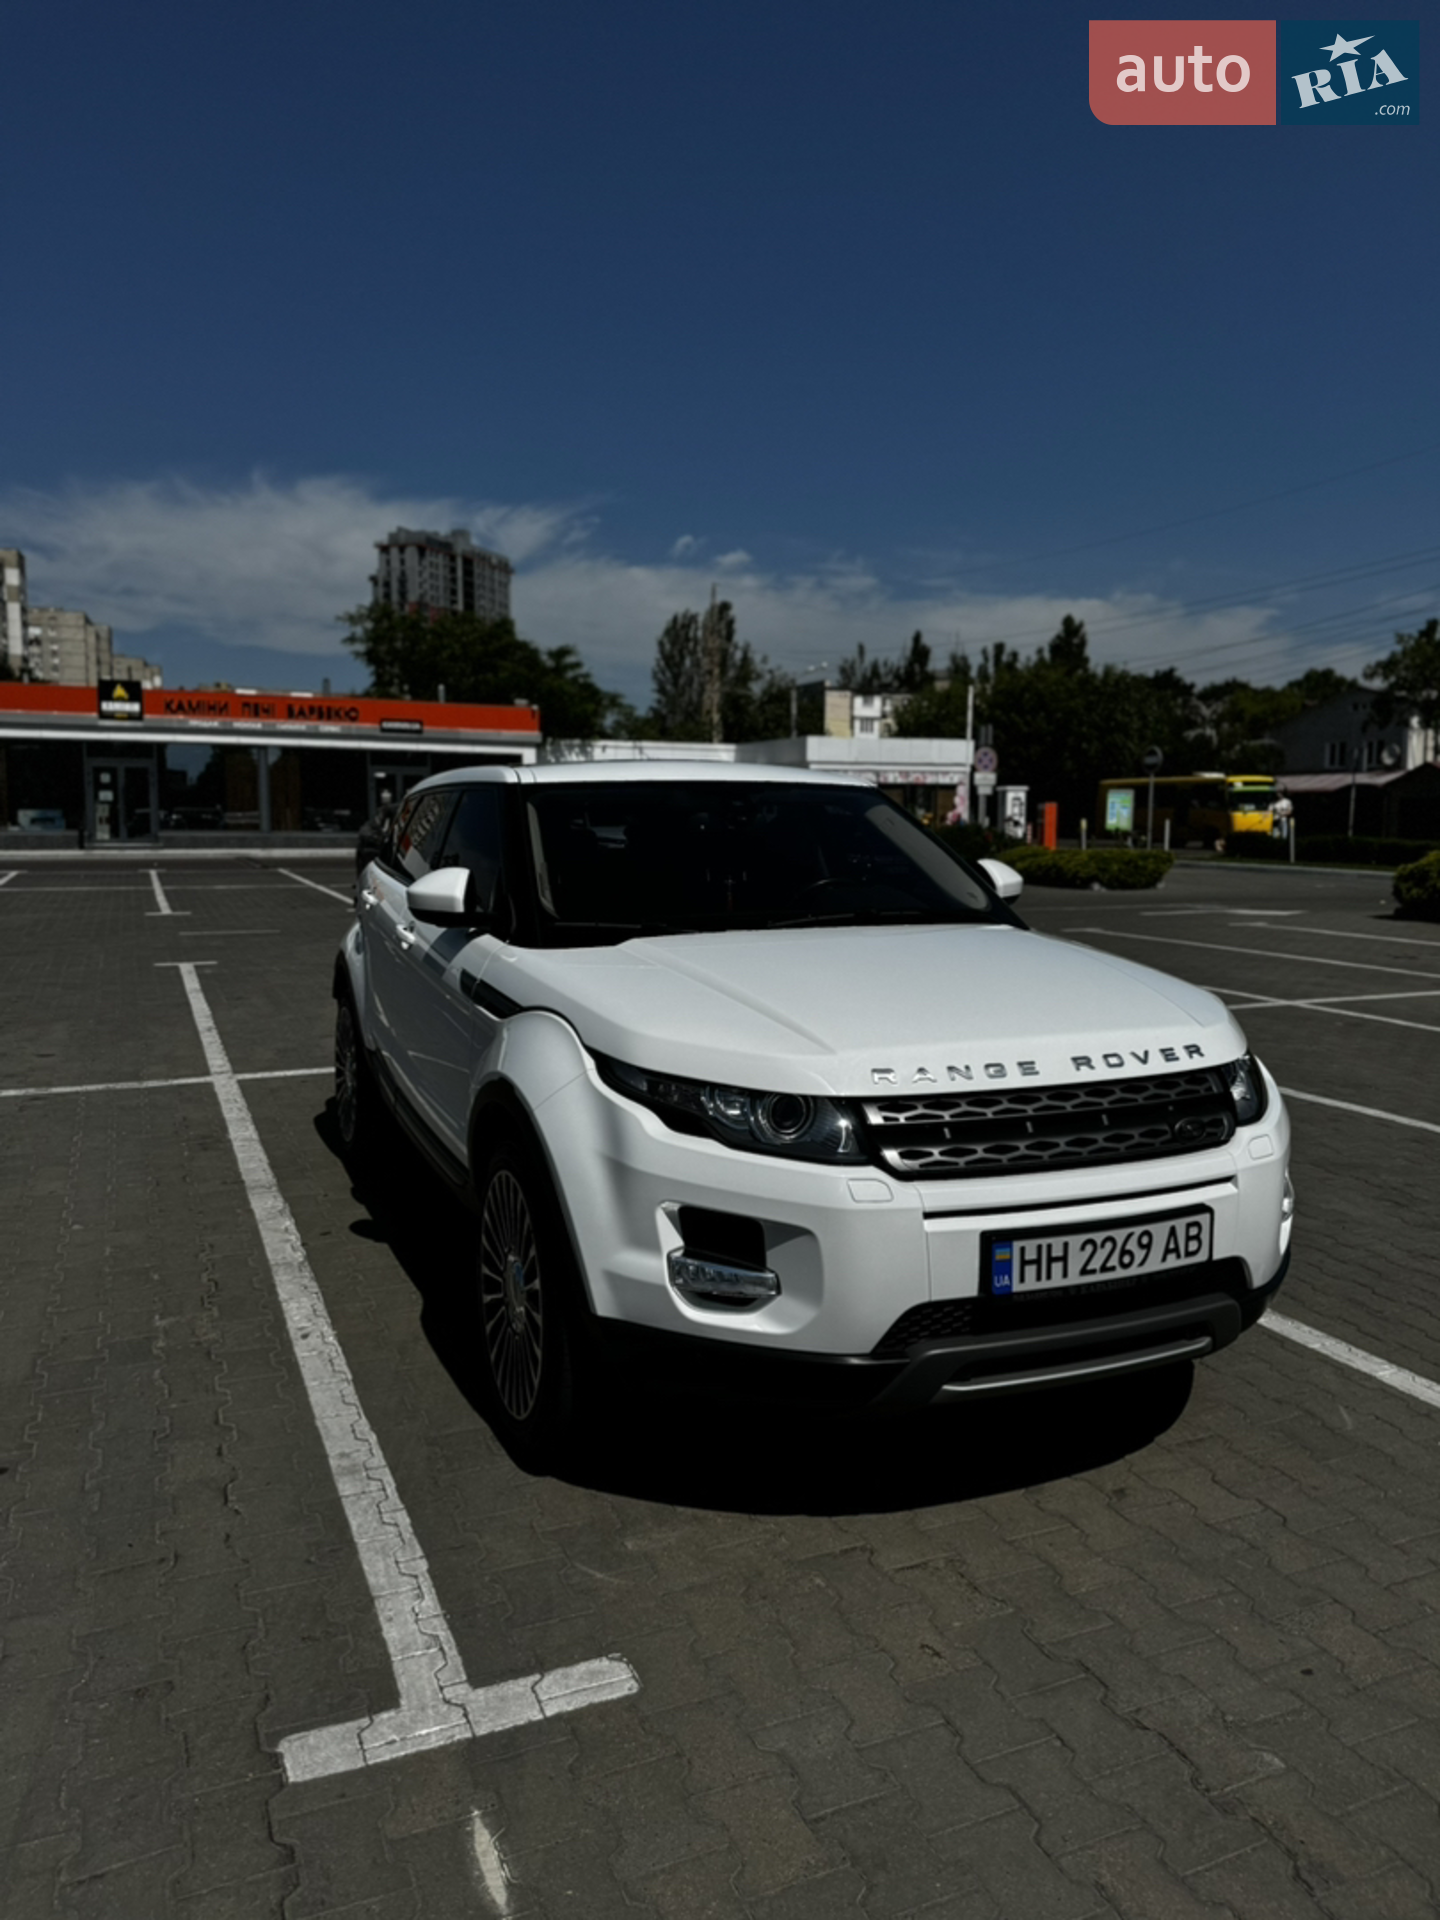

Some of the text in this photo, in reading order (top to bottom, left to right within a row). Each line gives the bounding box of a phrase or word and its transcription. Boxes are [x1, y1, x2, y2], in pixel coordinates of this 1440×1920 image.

[870, 1043, 1206, 1085] RANGE ROVER
[1019, 1220, 1203, 1284] HH 2269 AB
[994, 1274, 1011, 1288] UA
